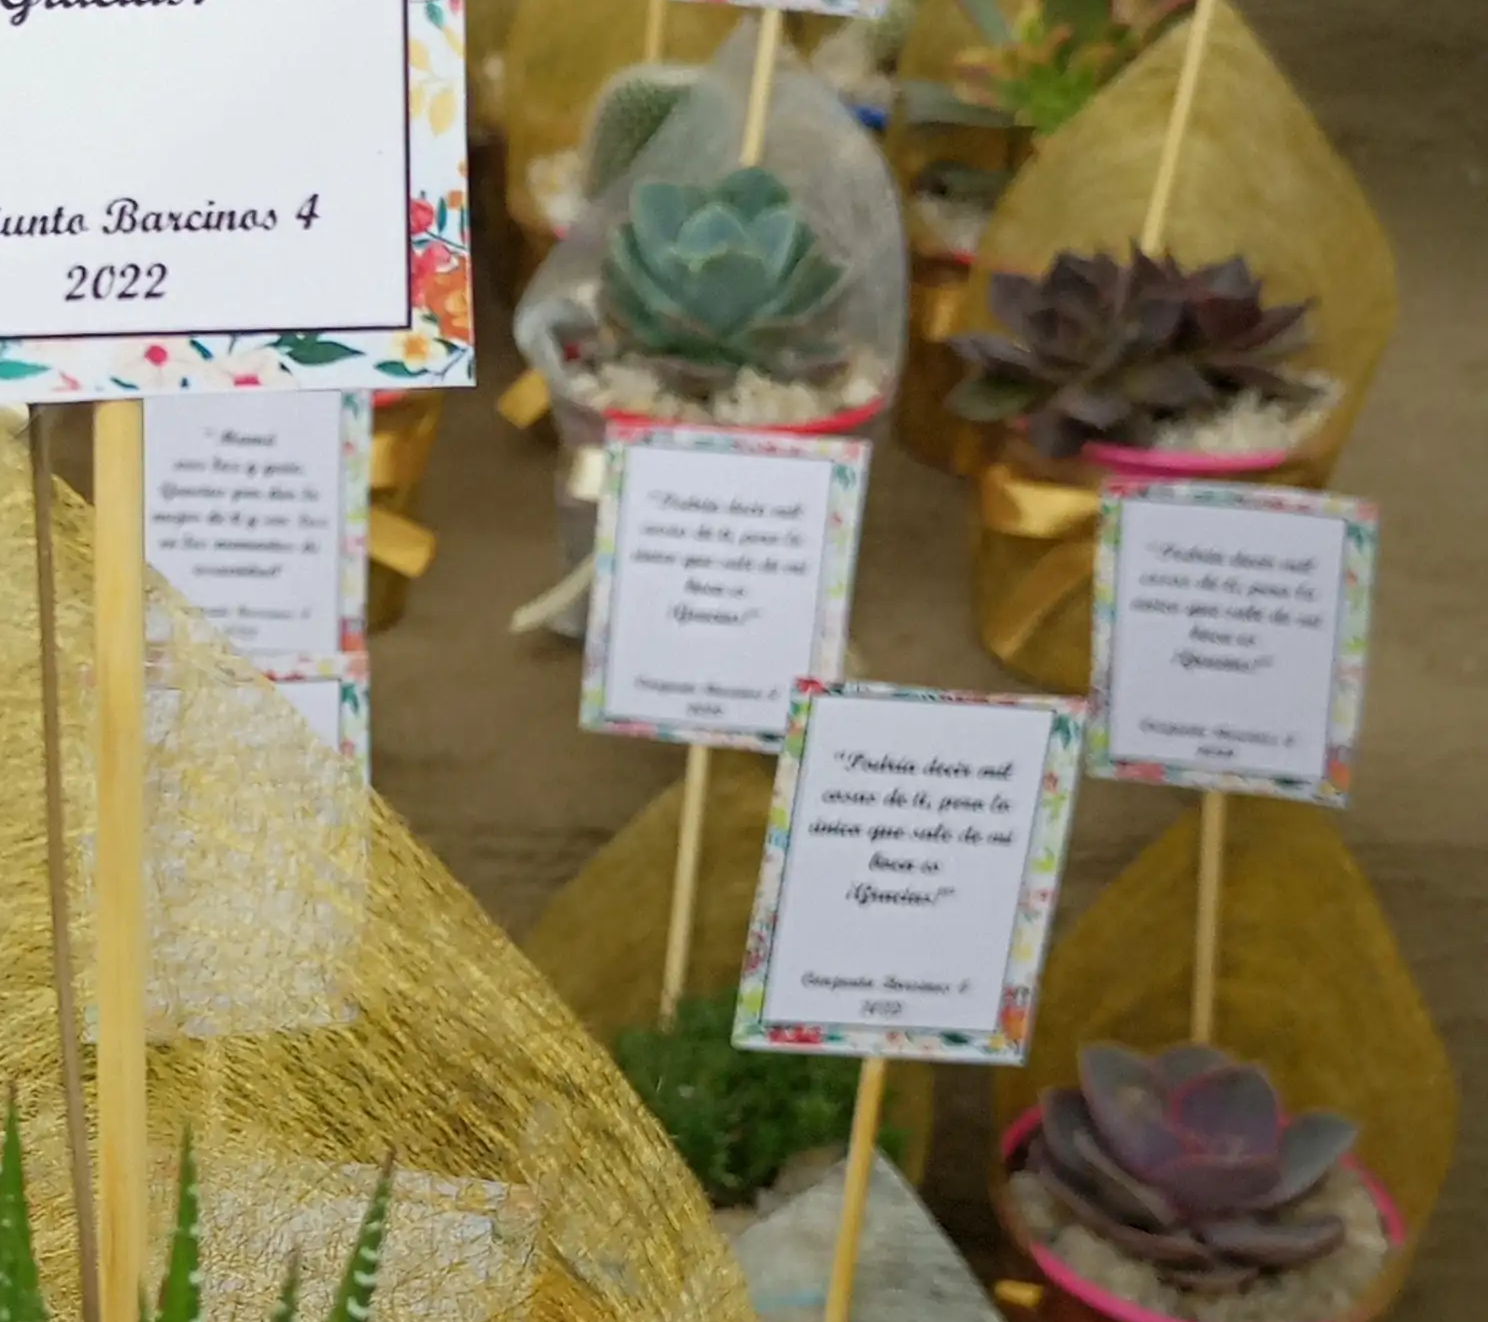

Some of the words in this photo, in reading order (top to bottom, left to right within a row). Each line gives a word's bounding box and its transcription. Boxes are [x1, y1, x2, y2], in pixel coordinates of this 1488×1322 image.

[102, 199, 277, 235] Barcinos
[296, 193, 320, 229] 4
[64, 263, 168, 301] 2022
